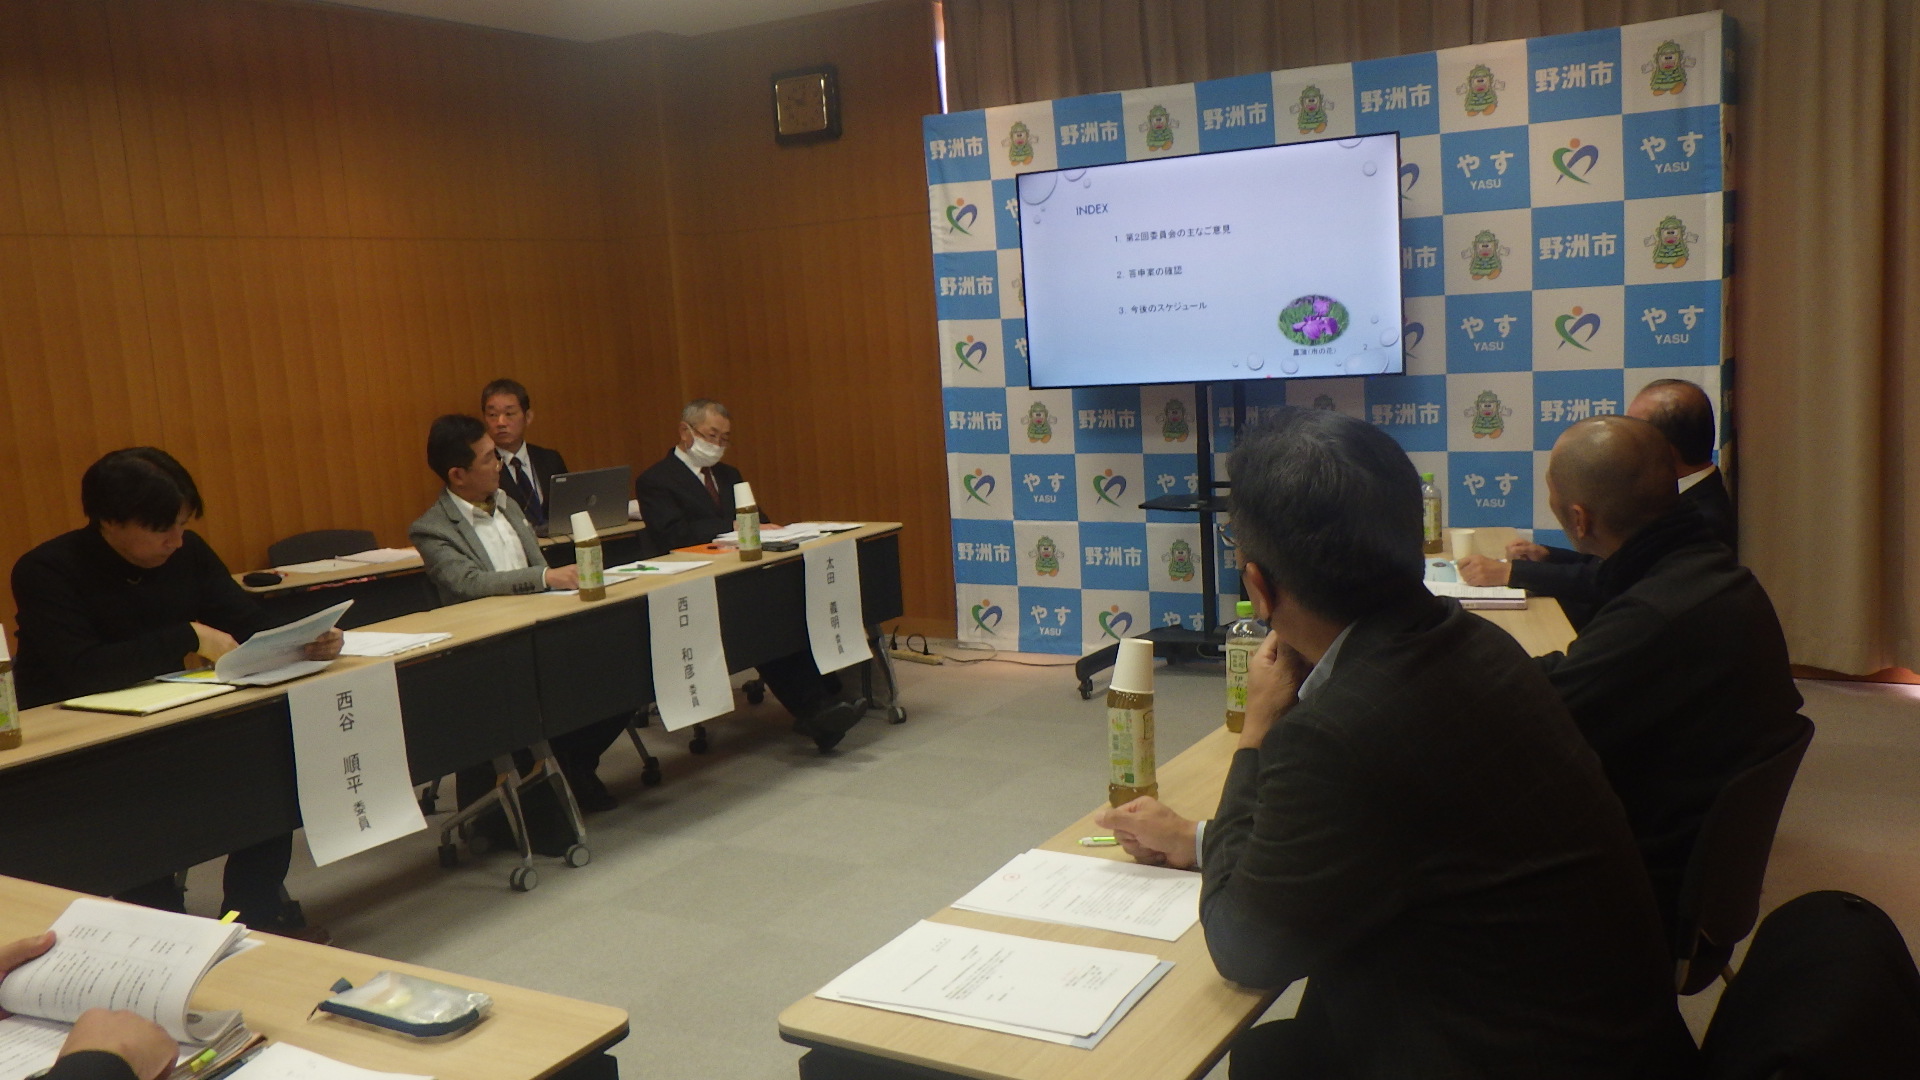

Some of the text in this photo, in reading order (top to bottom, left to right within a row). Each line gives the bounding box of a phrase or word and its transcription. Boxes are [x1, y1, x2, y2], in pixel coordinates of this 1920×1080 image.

[1534, 60, 1614, 93] 野洲市
[1360, 83, 1432, 113] 野洲市
[1202, 102, 1268, 131] 野洲市
[1060, 120, 1118, 146] 野洲市
[929, 135, 984, 160] 野洲市
[1640, 131, 1704, 161] やす
[1457, 150, 1515, 178] やす
[1654, 161, 1691, 174] YASU
[1469, 178, 1502, 190] YASU
[1076, 203, 1109, 216] INDEX
[1538, 231, 1617, 260] 野洲市
[939, 275, 994, 296] 野洲市
[1131, 302, 1207, 315] 今後のスケジュール
[1641, 304, 1705, 332] やす
[1460, 314, 1518, 339] やす
[1473, 341, 1505, 352] YASU
[1654, 333, 1690, 345] YASU
[949, 410, 1003, 431] 野洲市
[1078, 408, 1136, 430] 野洲市
[1371, 402, 1441, 425] 野洲市
[1022, 473, 1066, 493] やす
[1463, 473, 1519, 496] やす
[1033, 494, 1057, 504] YASU
[1475, 498, 1506, 508] YASU
[957, 542, 1011, 563] 野洲市
[1084, 546, 1142, 567] 野洲市
[678, 596, 689, 628] 西口
[1030, 605, 1072, 626] やす
[1039, 626, 1062, 637] YASU
[336, 690, 371, 831] 西谷 順平 委員
